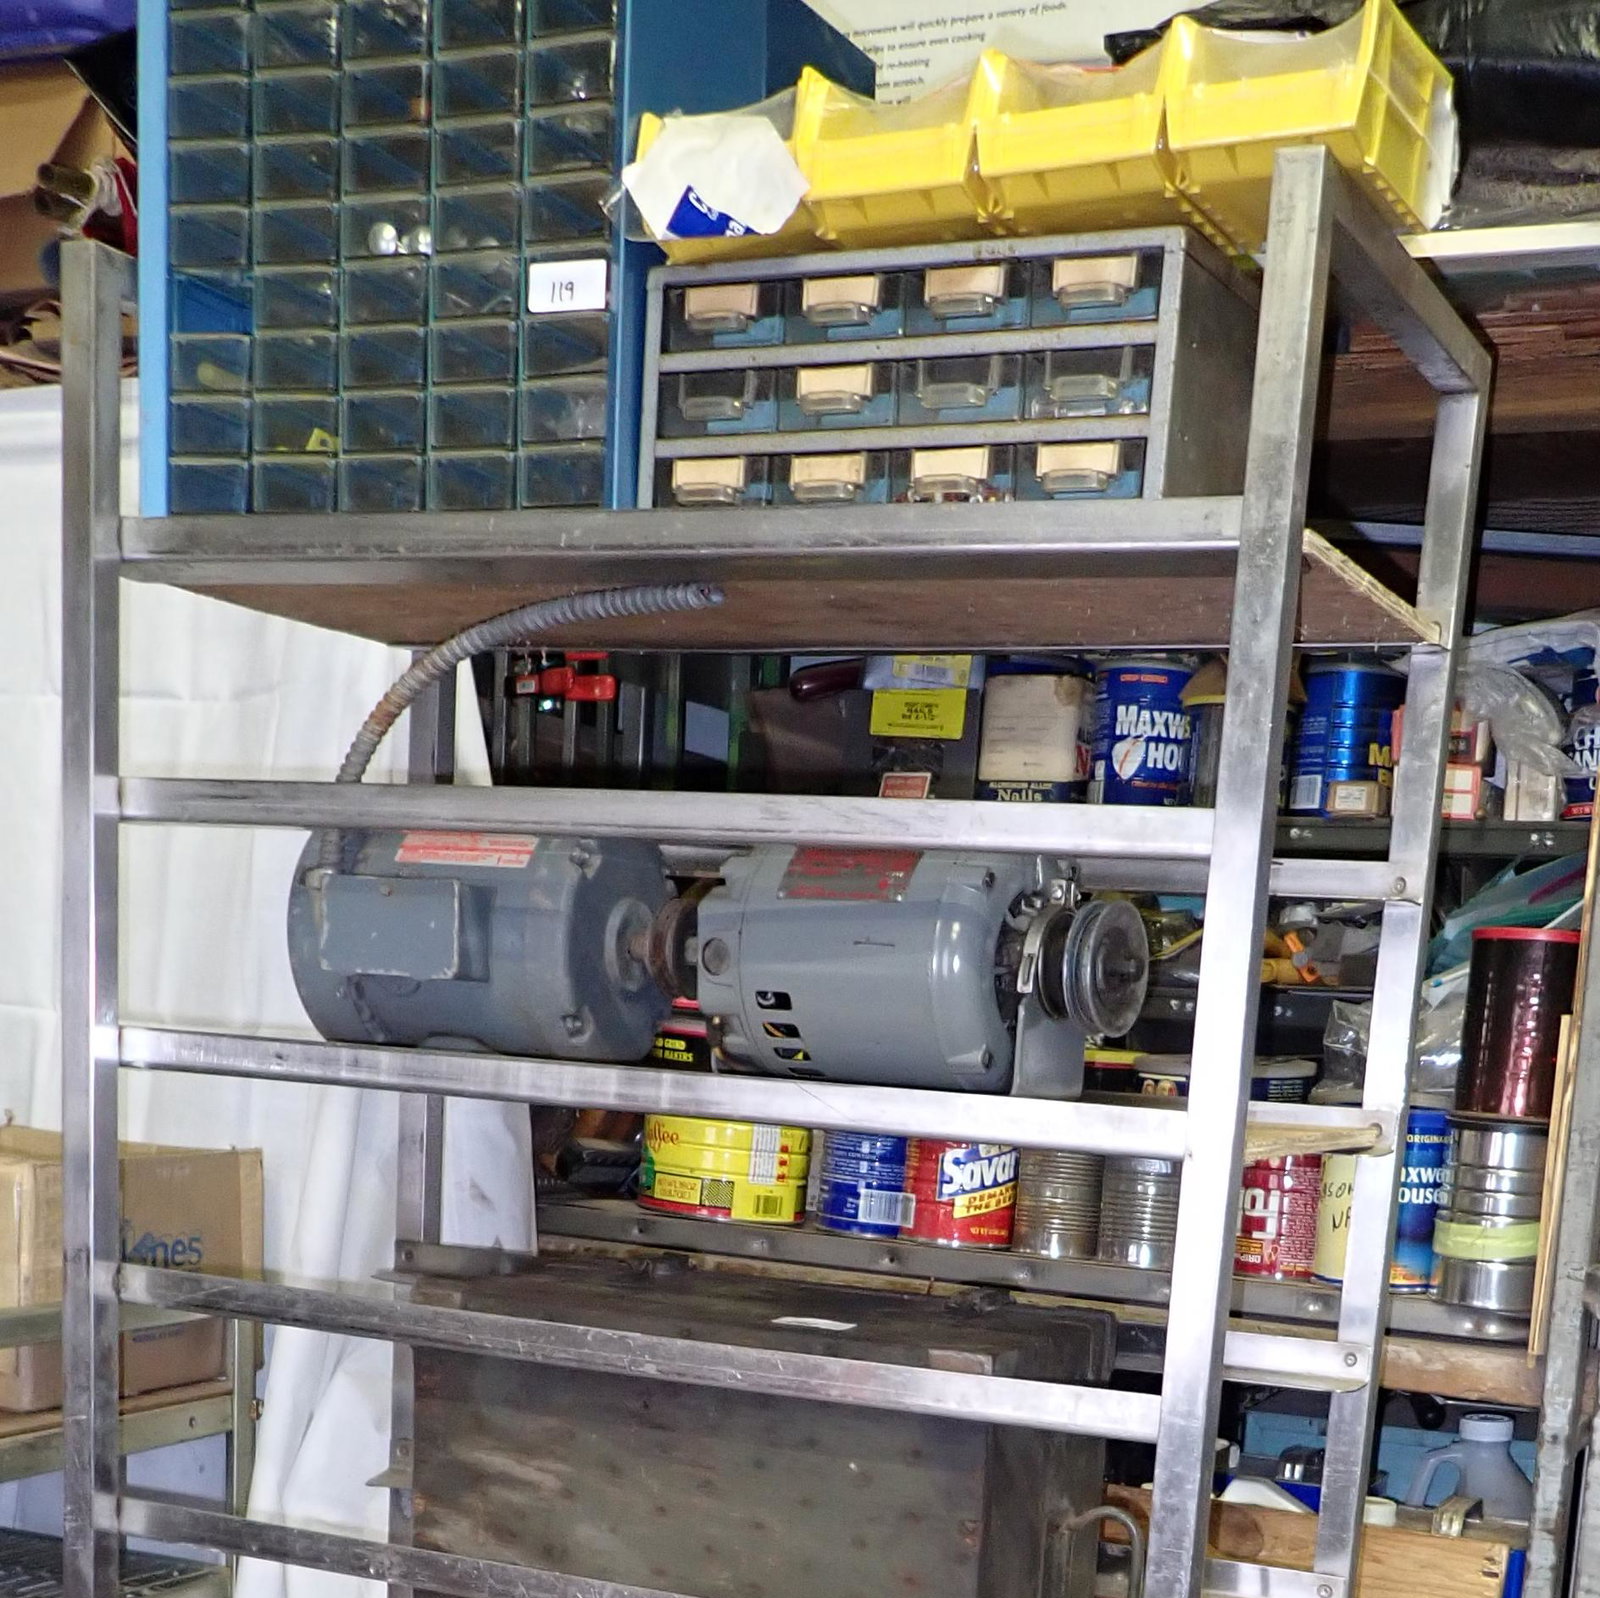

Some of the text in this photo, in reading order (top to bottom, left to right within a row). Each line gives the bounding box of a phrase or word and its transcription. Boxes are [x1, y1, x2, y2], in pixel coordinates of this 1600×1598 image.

[853, 26, 897, 37] microwave
[900, 21, 915, 31] will
[917, 17, 948, 31] quickly
[950, 14, 985, 27] prepare
[996, 8, 1026, 19] variety
[1029, 4, 1039, 15] of
[899, 40, 927, 50] ensure
[929, 37, 949, 46] even
[951, 32, 986, 43] cooking
[551, 281, 574, 303] 119
[997, 788, 1042, 801] Nails
